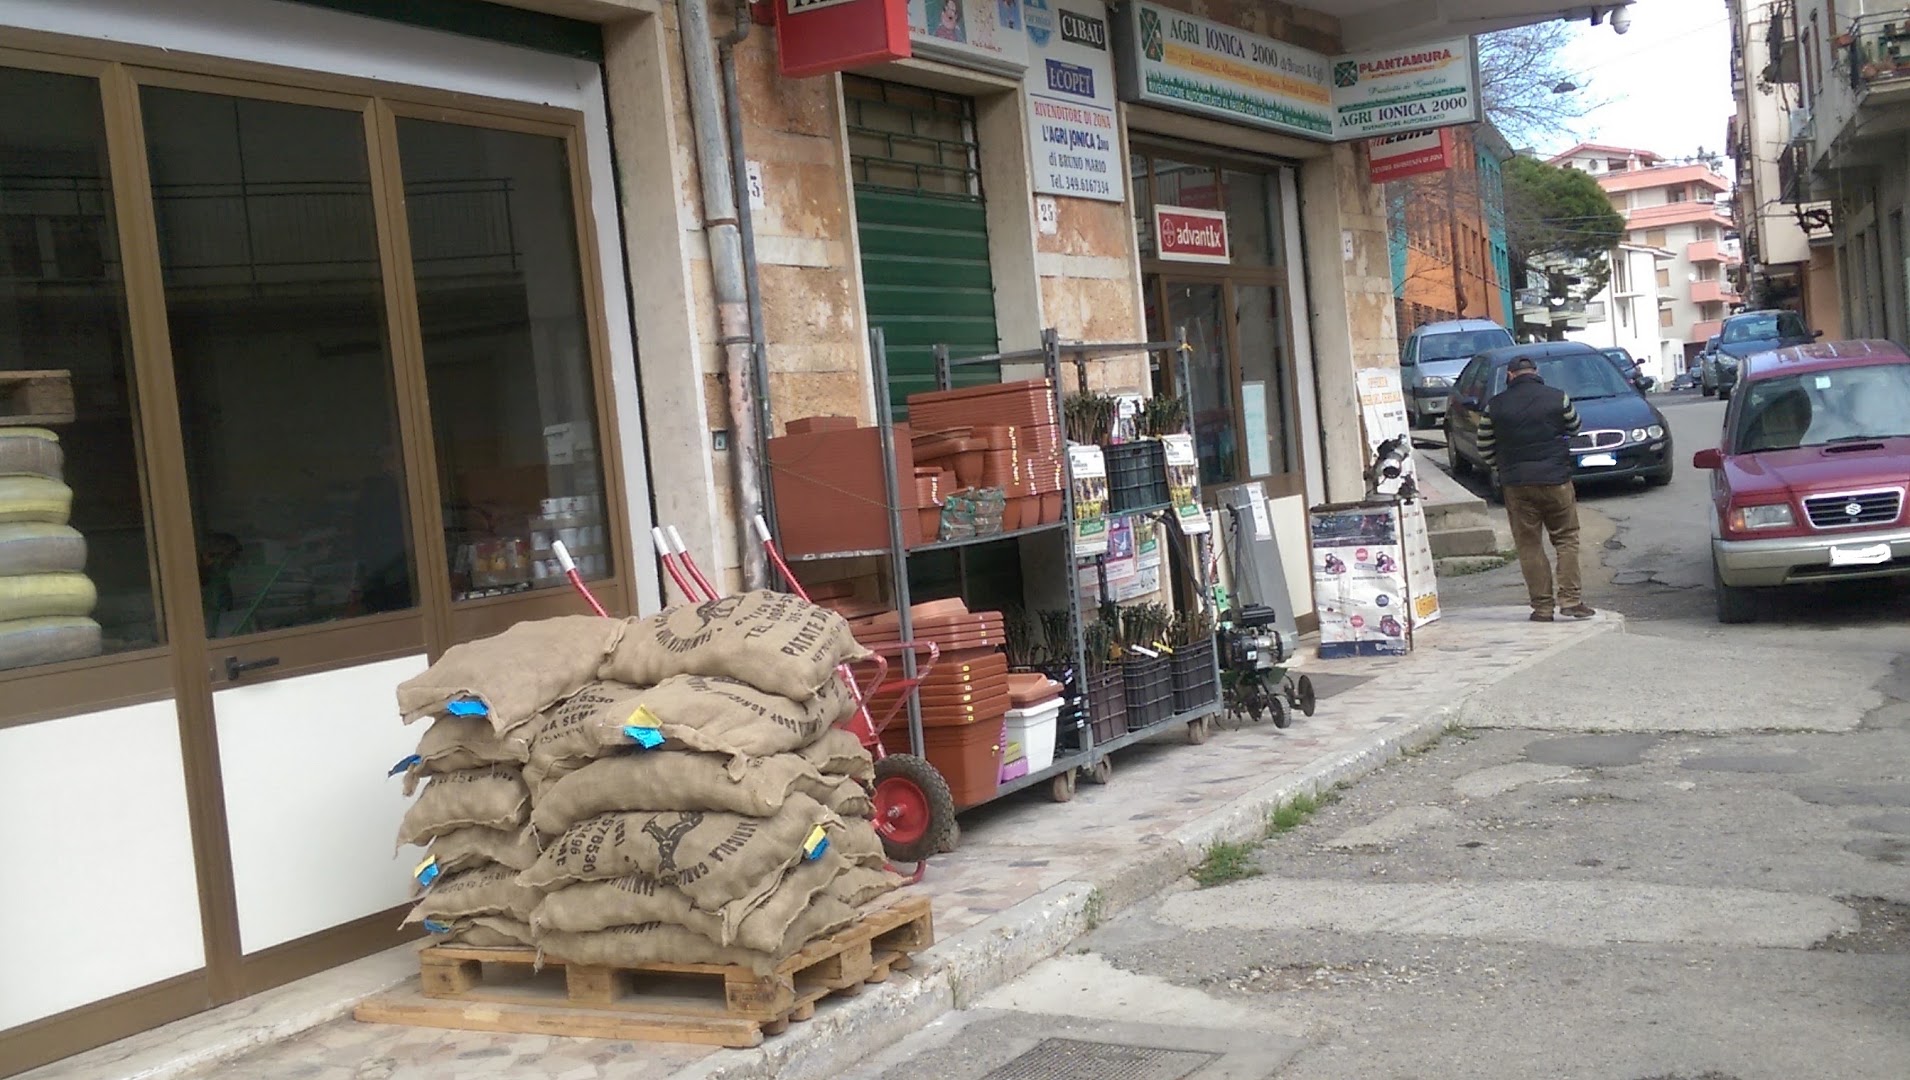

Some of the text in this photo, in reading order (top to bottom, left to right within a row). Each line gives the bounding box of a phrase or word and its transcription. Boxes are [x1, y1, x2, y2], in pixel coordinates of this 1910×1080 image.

[1062, 14, 1104, 45] CIBAU
[1170, 18, 1200, 45] AGRI
[1206, 27, 1246, 59] IONICA
[1251, 42, 1278, 68] 2000
[1359, 49, 1452, 73] PLANTAMURA
[1050, 67, 1091, 94] ECOPET
[1034, 101, 1111, 129] RIVENDITORE DI ZONA
[1339, 111, 1372, 128] AGRI
[1378, 103, 1427, 121] IONICA
[1432, 96, 1468, 112] 2000
[1042, 124, 1068, 145] L'AGRI
[1058, 154, 1083, 170] BRUNO
[1085, 158, 1107, 173] MARIO
[1040, 203, 1054, 221] 25
[1177, 221, 1222, 248] advantix
[780, 621, 825, 657] PATATE
